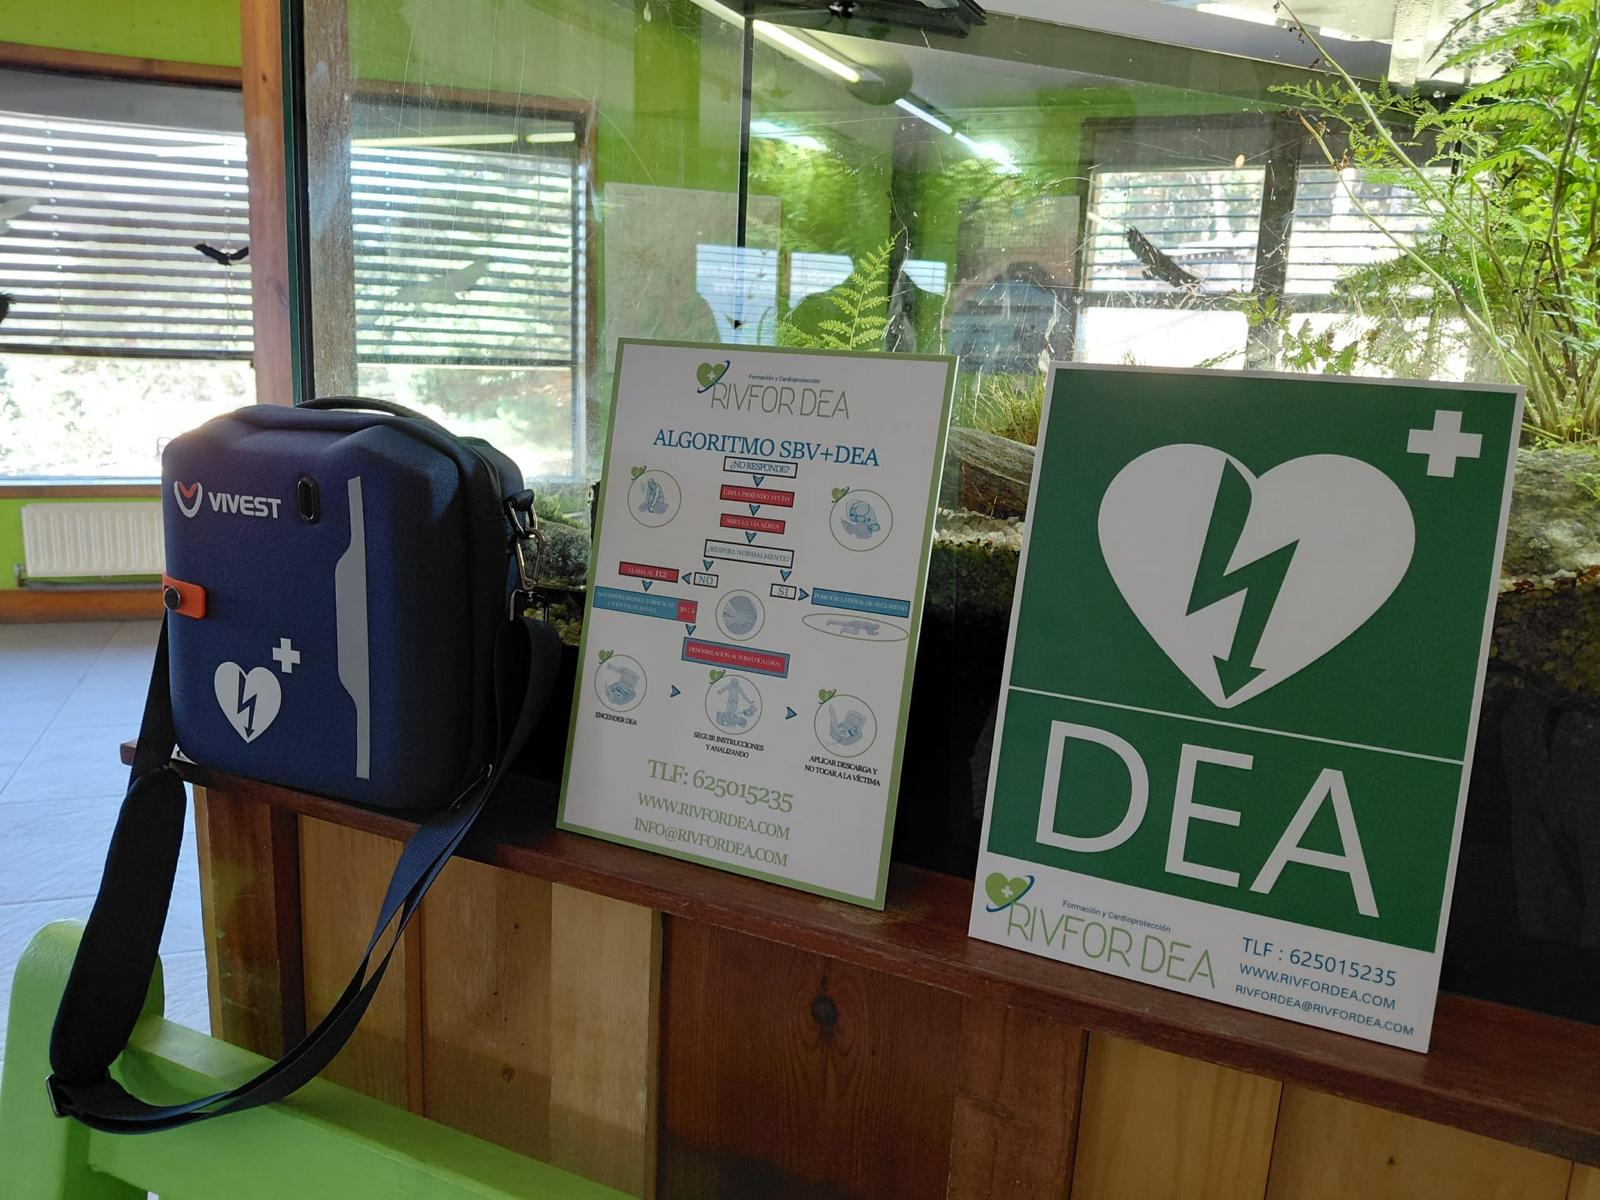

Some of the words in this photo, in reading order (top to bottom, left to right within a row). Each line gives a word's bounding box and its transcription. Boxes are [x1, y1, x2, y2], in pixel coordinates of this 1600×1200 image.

[711, 382, 795, 416] RIVFOR
[800, 388, 849, 420] DEA
[653, 429, 775, 457] ALGORITMO
[779, 440, 880, 467] SBV+DEA
[730, 461, 745, 470] ¿NO
[746, 463, 790, 473] RESPONDE?
[208, 491, 281, 519] VIVEST
[736, 549, 790, 562] NORMALMENTE?
[655, 570, 668, 578] 112
[698, 575, 713, 585] NO
[595, 711, 624, 723] ENCENDER
[625, 717, 637, 725] DEA
[694, 731, 715, 741] SEGUIR
[716, 736, 765, 751] INSTRUCCIONES
[711, 745, 749, 758] ANALIZANDO
[804, 764, 815, 772] NO
[815, 766, 838, 777] TOCAR
[842, 772, 852, 780] LA
[852, 773, 880, 786] VÍCTIMA
[809, 756, 836, 766] APLICAR
[837, 760, 872, 774] DESCARGA
[873, 767, 878, 775] Y
[648, 759, 688, 785] TLF:
[692, 770, 793, 813] 625015235
[638, 792, 790, 840] WWW.RIVFORDEA.COM
[1035, 720, 1380, 918] DEA
[634, 817, 789, 867] INFO@RIVFORDEA.COM
[1062, 900, 1100, 916] Formación
[1101, 910, 1107, 918] y
[1108, 911, 1171, 933] Cardioprotección
[1007, 902, 1133, 967] RIVFOR
[1140, 934, 1215, 989] DEA
[1289, 949, 1397, 987] 625015235
[1239, 963, 1396, 1010] WWW.RIVFORDEA.COM
[1235, 984, 1415, 1036] RIVFORDEA@RIVFORDEA.COM
